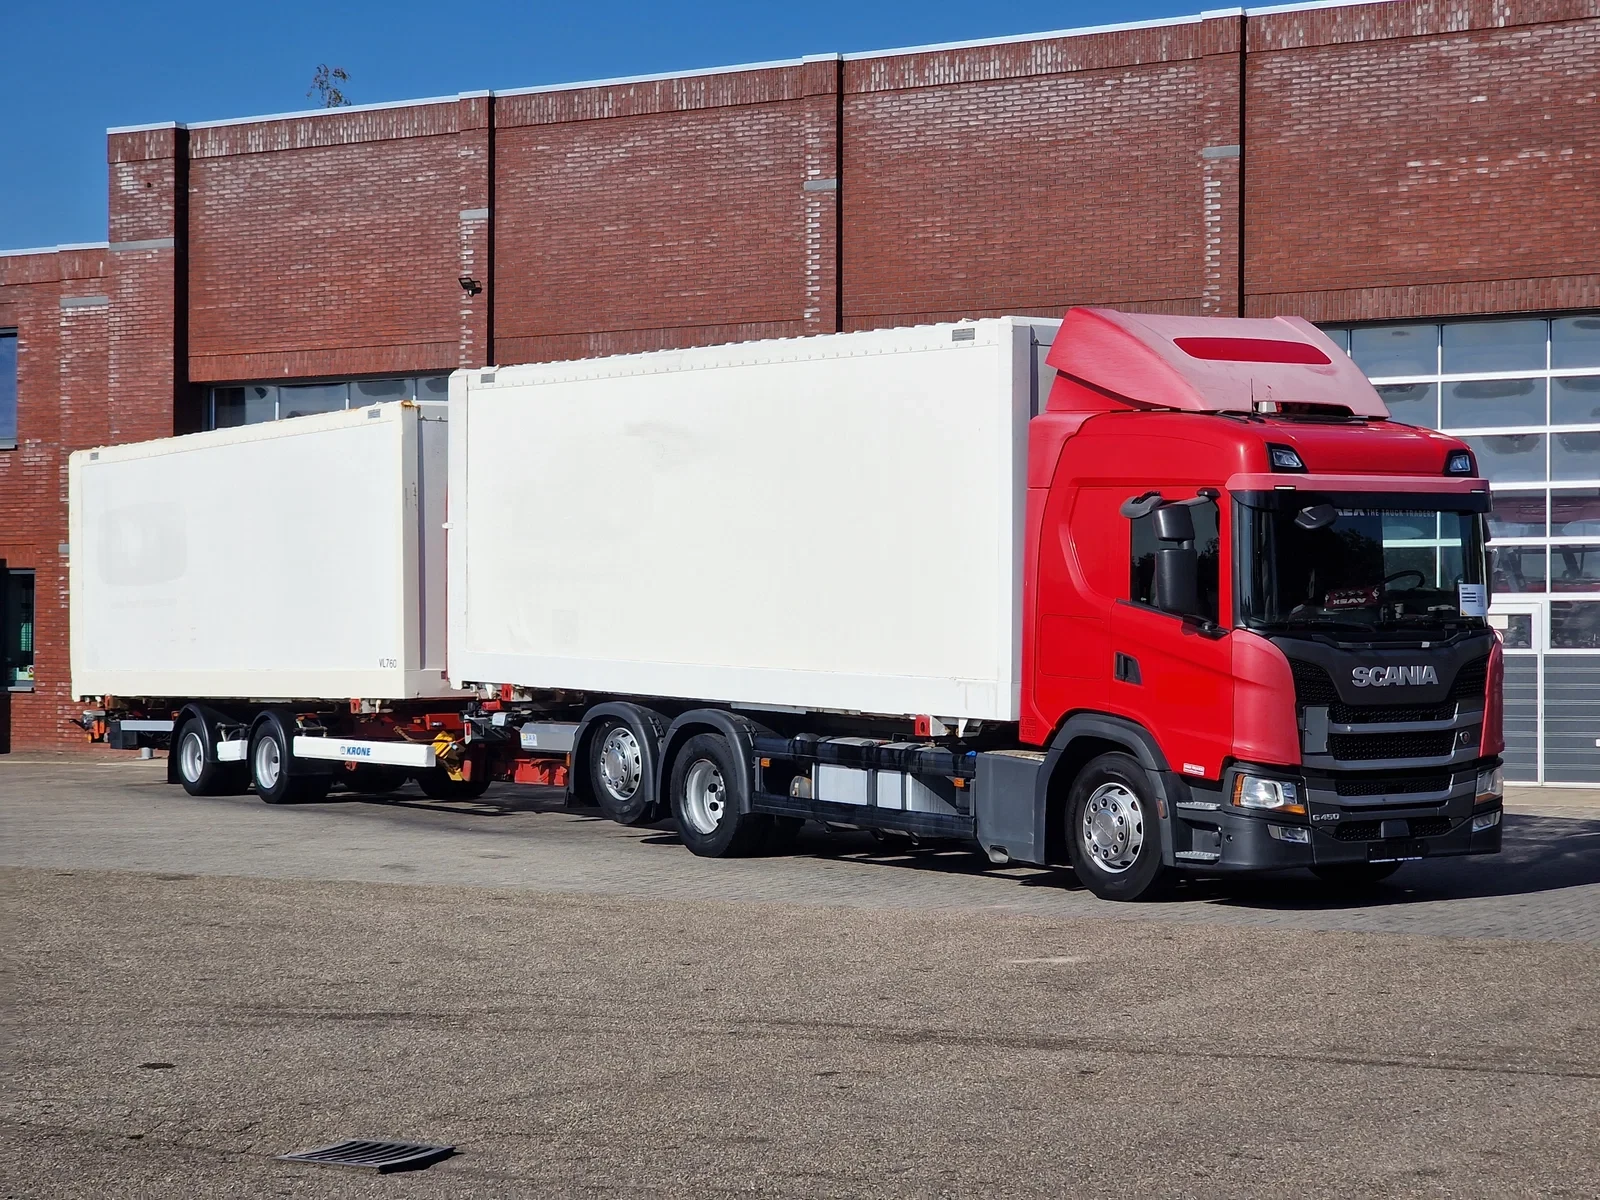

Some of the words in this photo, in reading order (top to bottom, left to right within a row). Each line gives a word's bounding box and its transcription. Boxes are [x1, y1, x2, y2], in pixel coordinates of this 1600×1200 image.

[1366, 508, 1379, 517] THE
[1381, 509, 1404, 517] TRUCK
[1405, 509, 1436, 518] TRADERS
[378, 657, 398, 669] VL760
[1352, 665, 1439, 687] SCANIA
[346, 746, 371, 756] KRONE
